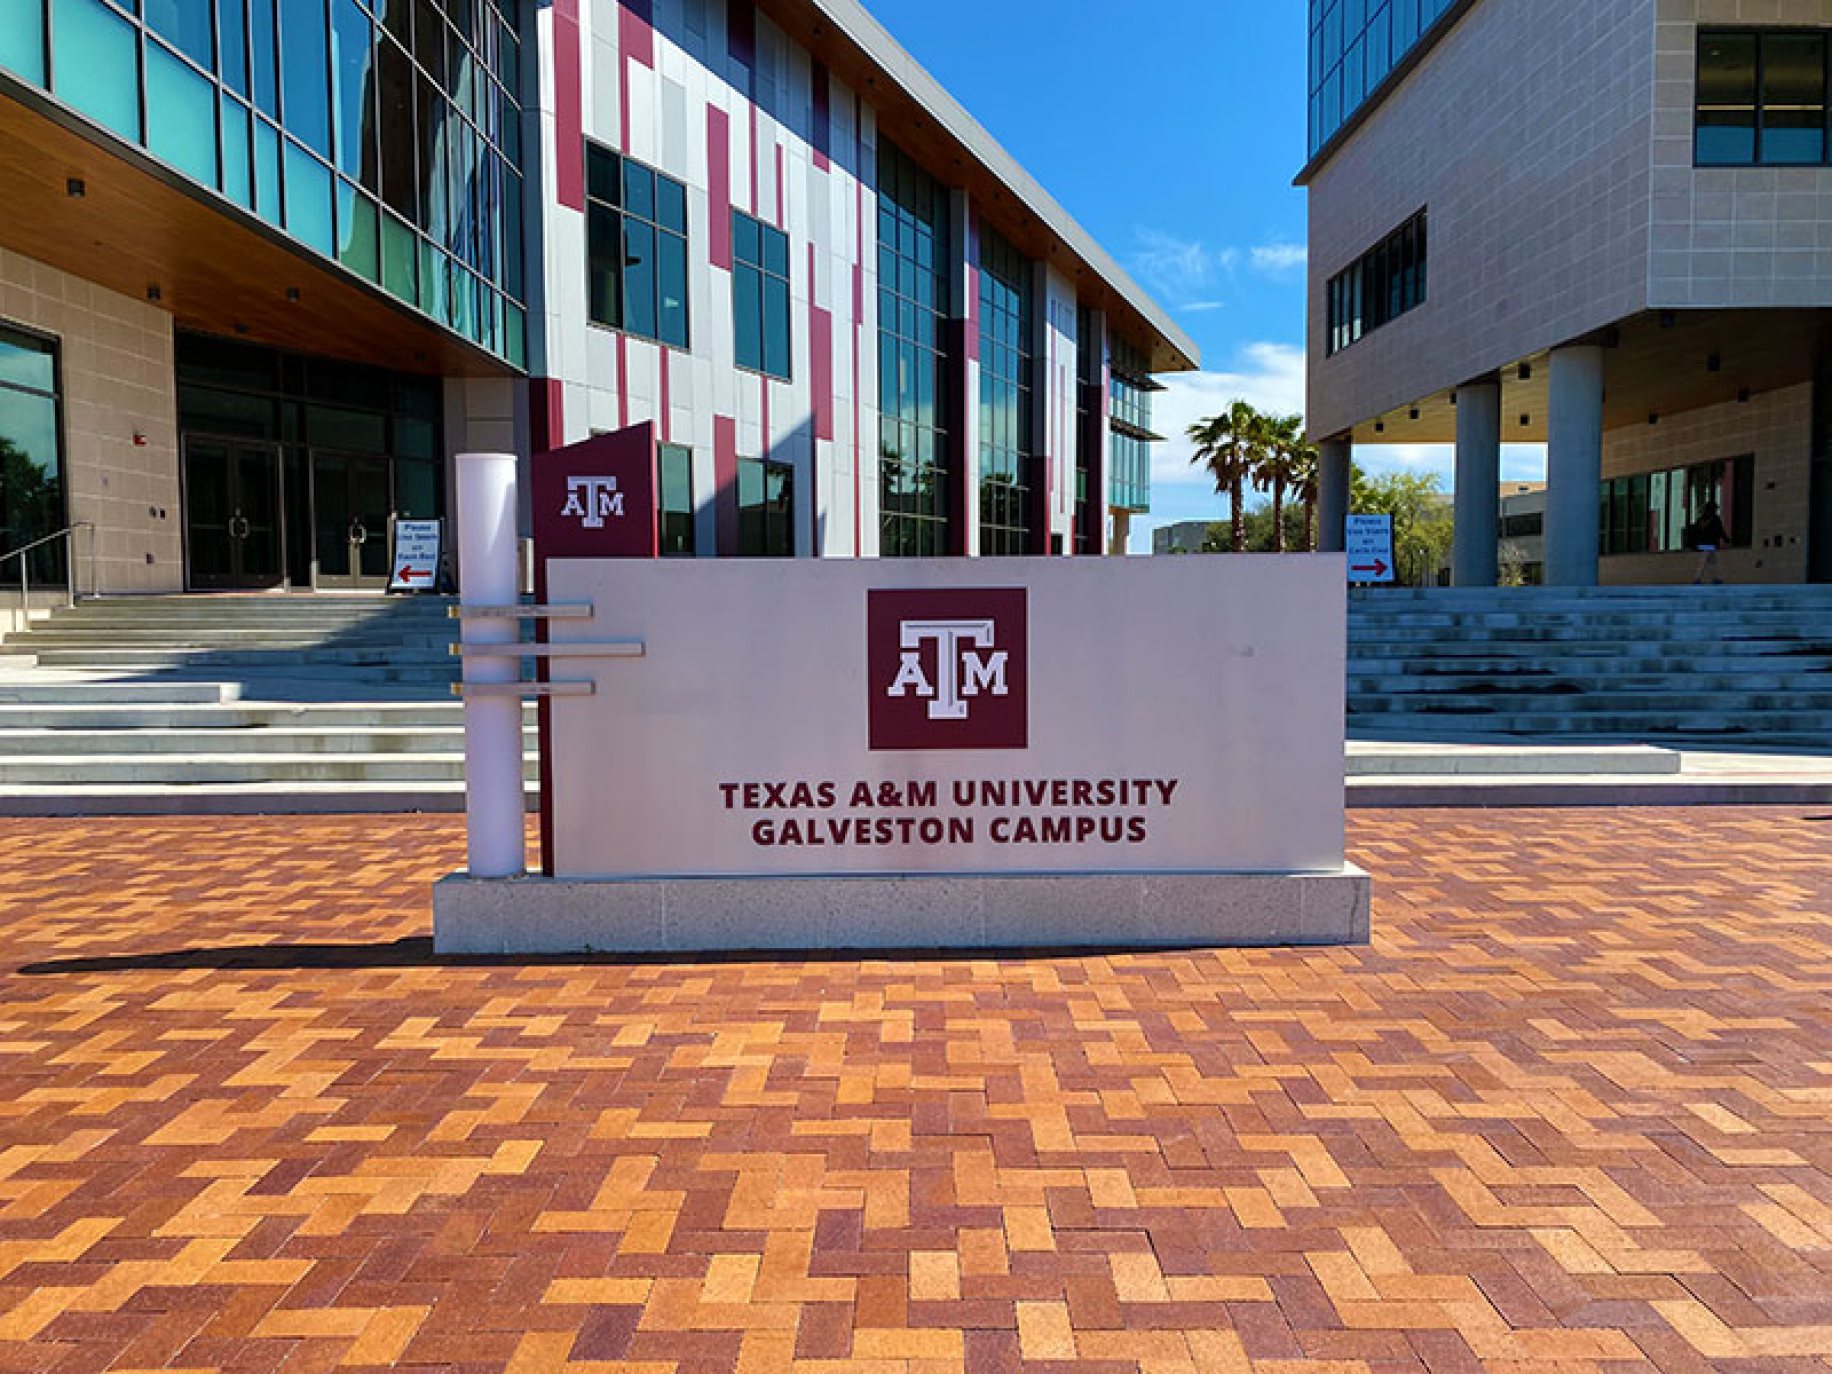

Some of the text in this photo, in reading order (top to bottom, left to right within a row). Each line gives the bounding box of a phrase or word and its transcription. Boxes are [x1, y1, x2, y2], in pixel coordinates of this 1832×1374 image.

[718, 778, 1178, 809] TEXAS A&M UNIVERSITY
[752, 816, 1146, 846] GALVESTON CAMPUS
